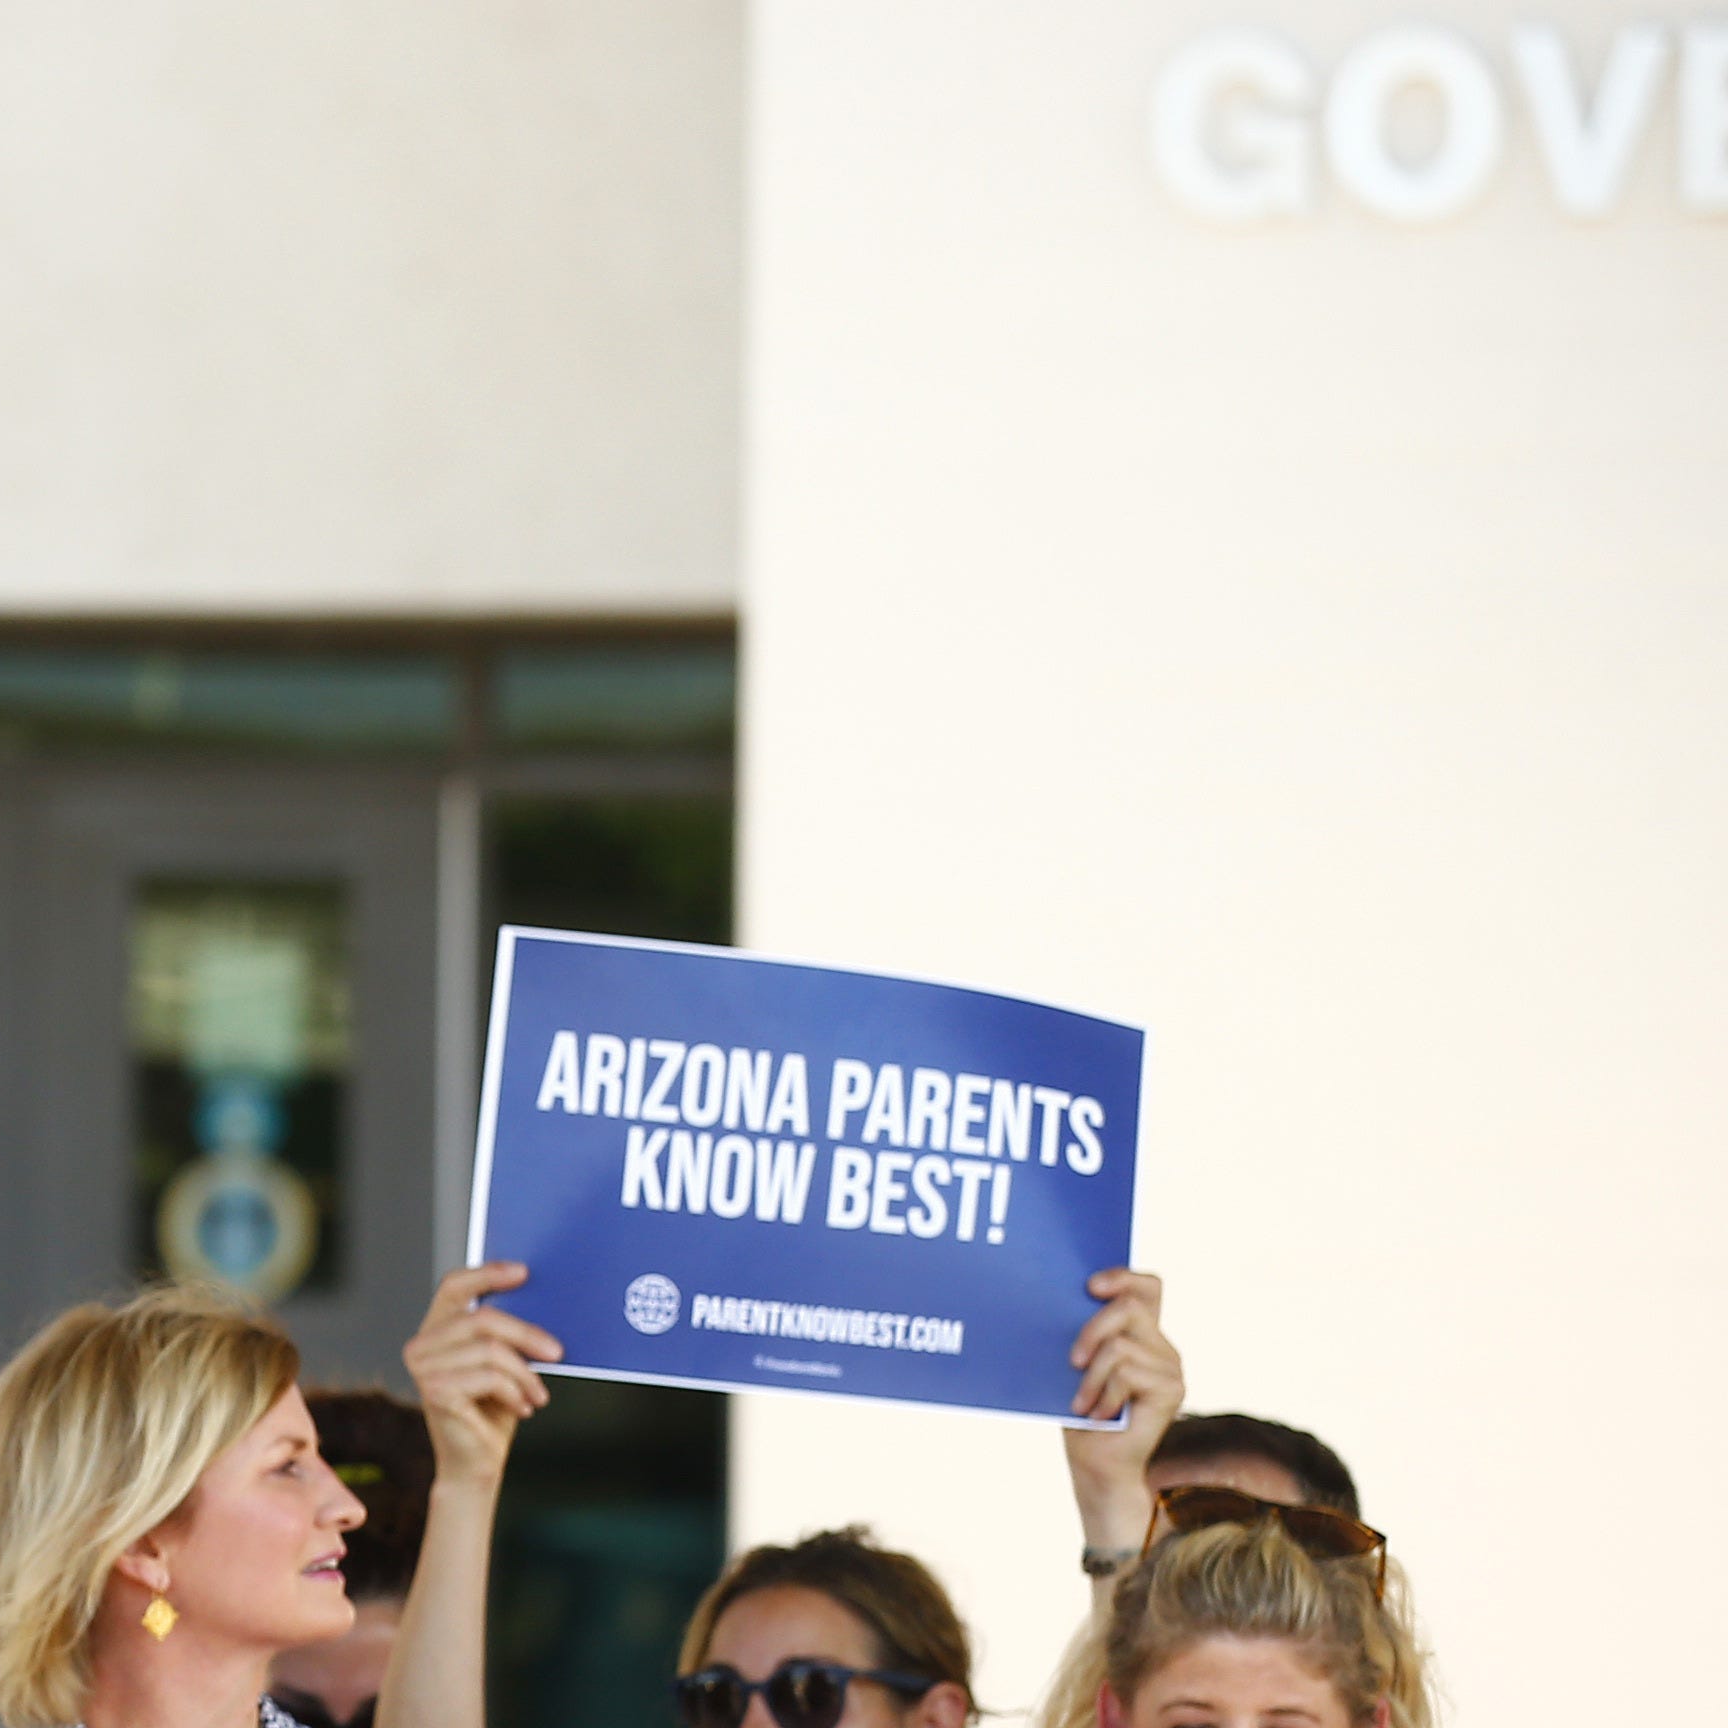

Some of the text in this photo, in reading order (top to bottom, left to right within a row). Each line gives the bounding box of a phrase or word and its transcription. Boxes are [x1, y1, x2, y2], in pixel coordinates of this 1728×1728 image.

[537, 1029, 1106, 1176] ARIZONA PARENTS
[620, 1125, 1012, 1245] KNOW BEST!
[691, 1293, 965, 1355] PARENTKNOWBEST.COM
